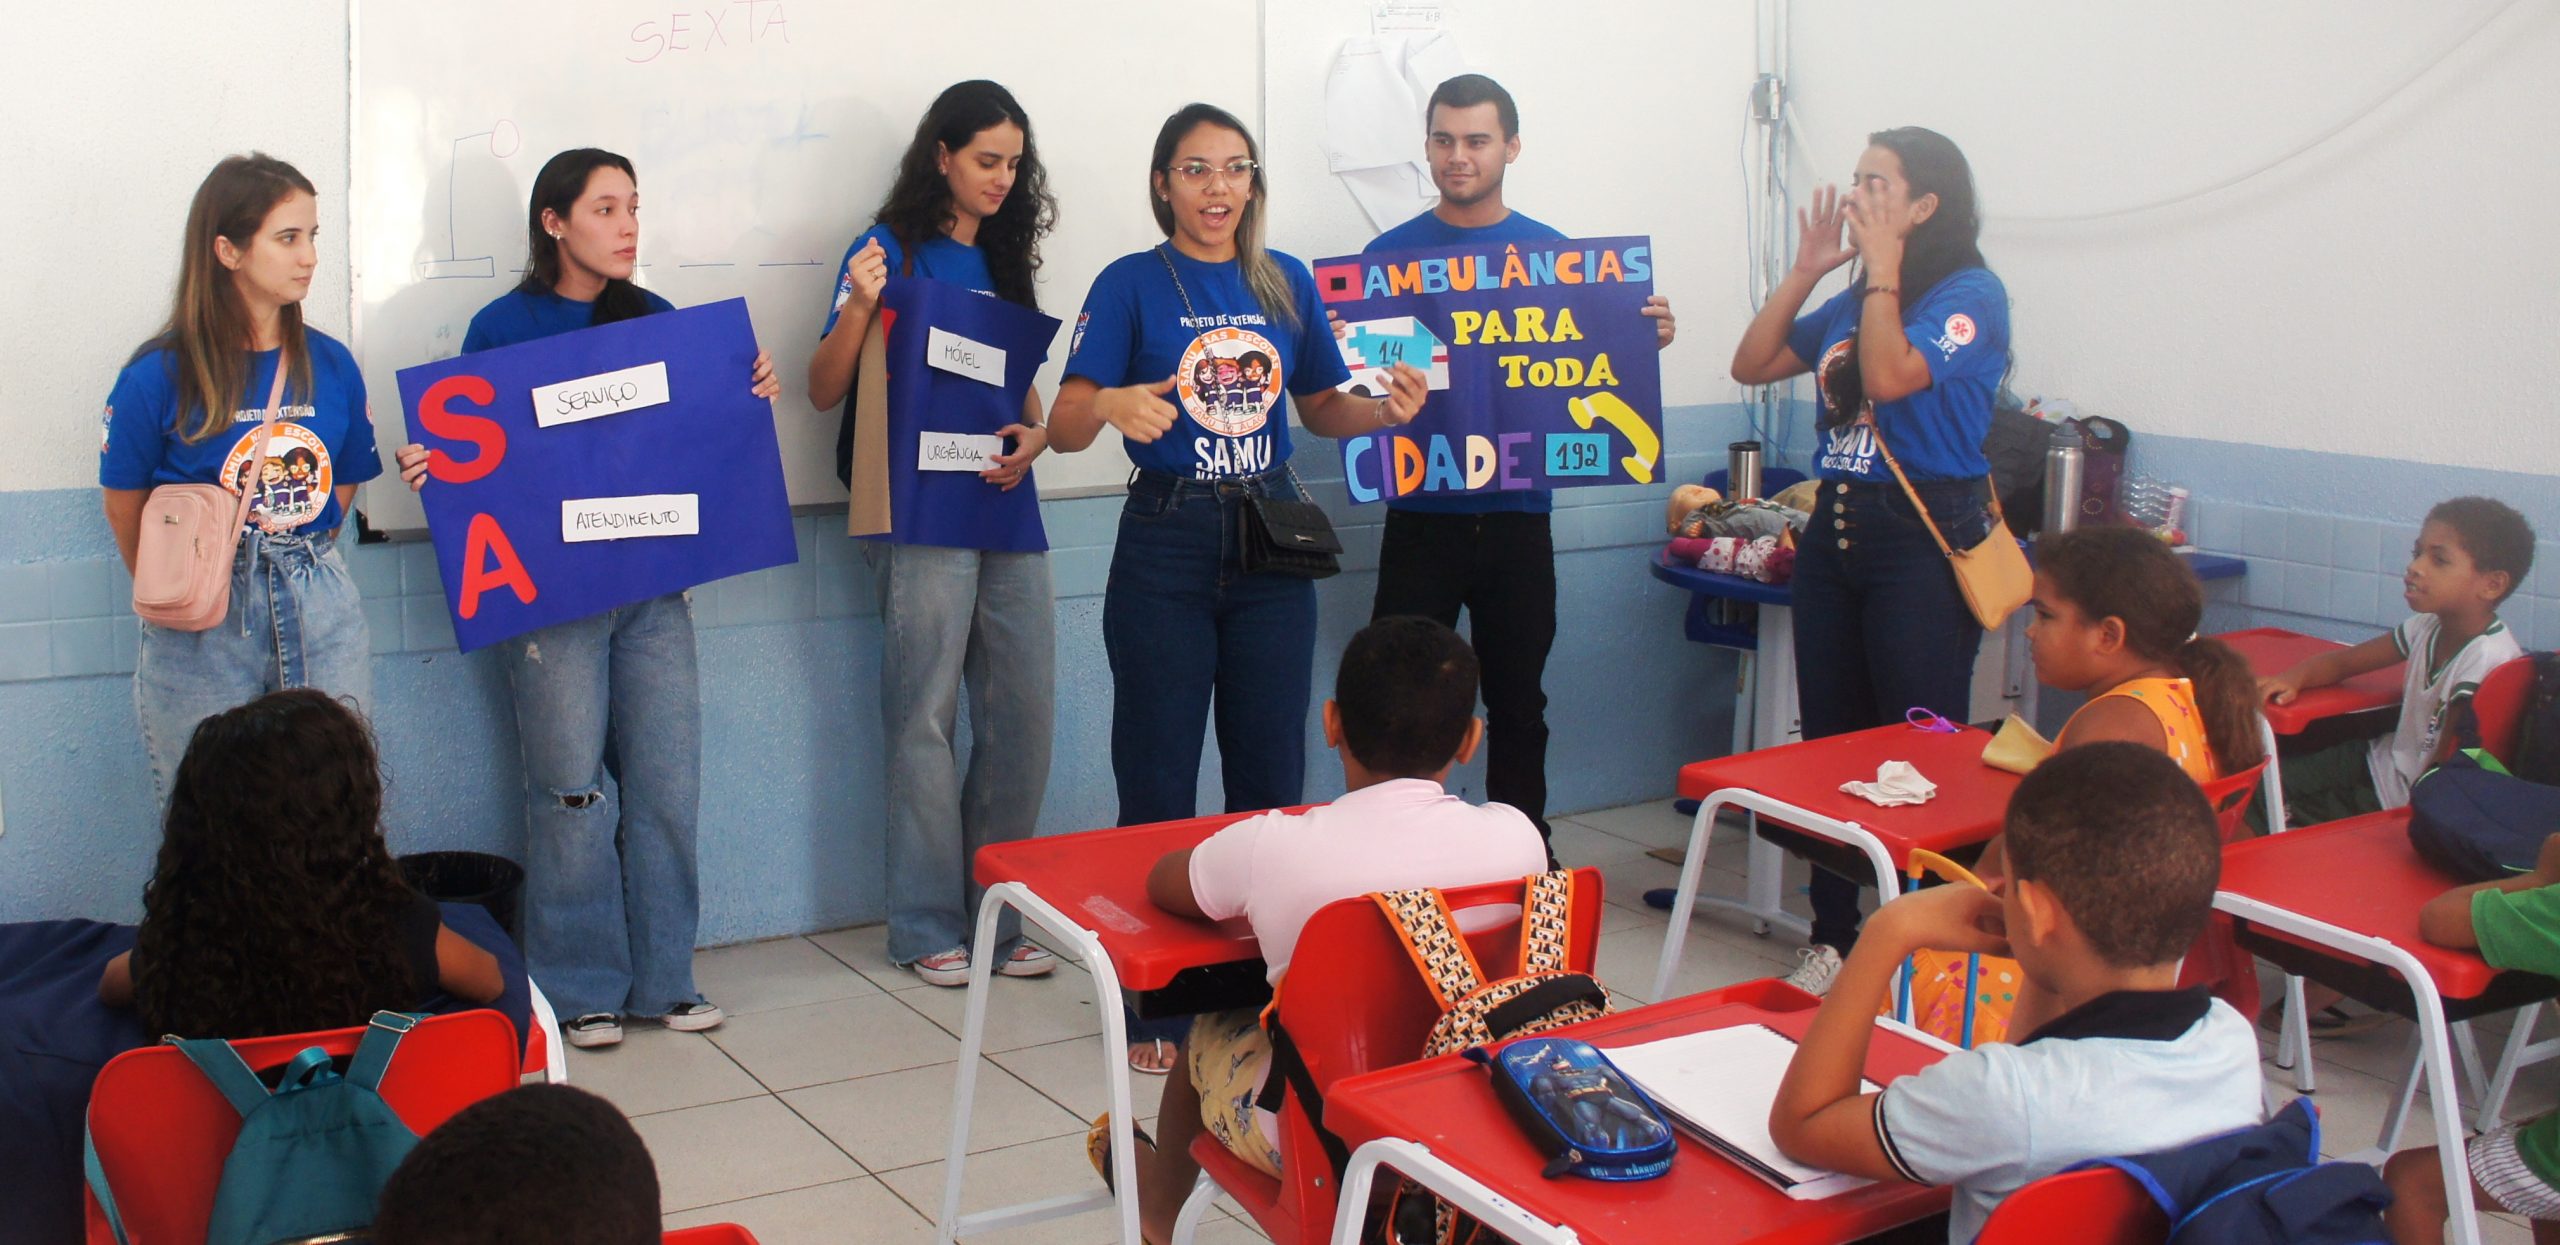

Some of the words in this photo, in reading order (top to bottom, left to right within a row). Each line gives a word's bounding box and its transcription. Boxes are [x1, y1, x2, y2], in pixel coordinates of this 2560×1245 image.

[625, 0, 791, 63] SEXTA
[1363, 243, 1651, 300] AMBULÂNCIAS
[1216, 314, 1228, 326] DE
[1450, 306, 1584, 346] PARA
[944, 341, 981, 369] MÓVEL
[1180, 350, 1198, 387] SAMU
[1238, 332, 1279, 370] ESCOLAS
[1378, 339, 1404, 366] 14
[556, 381, 638, 415] SERVIÇO
[418, 375, 507, 484] S
[223, 452, 243, 487] SAMU
[283, 426, 329, 468] ESCOLAS
[926, 440, 984, 463] URGÊNCIA
[1194, 434, 1272, 475] SAMU
[1345, 431, 1533, 503] CIDADE
[1555, 442, 1600, 471] 192
[576, 509, 681, 531] ATENDIMENTO
[458, 512, 538, 620] A
